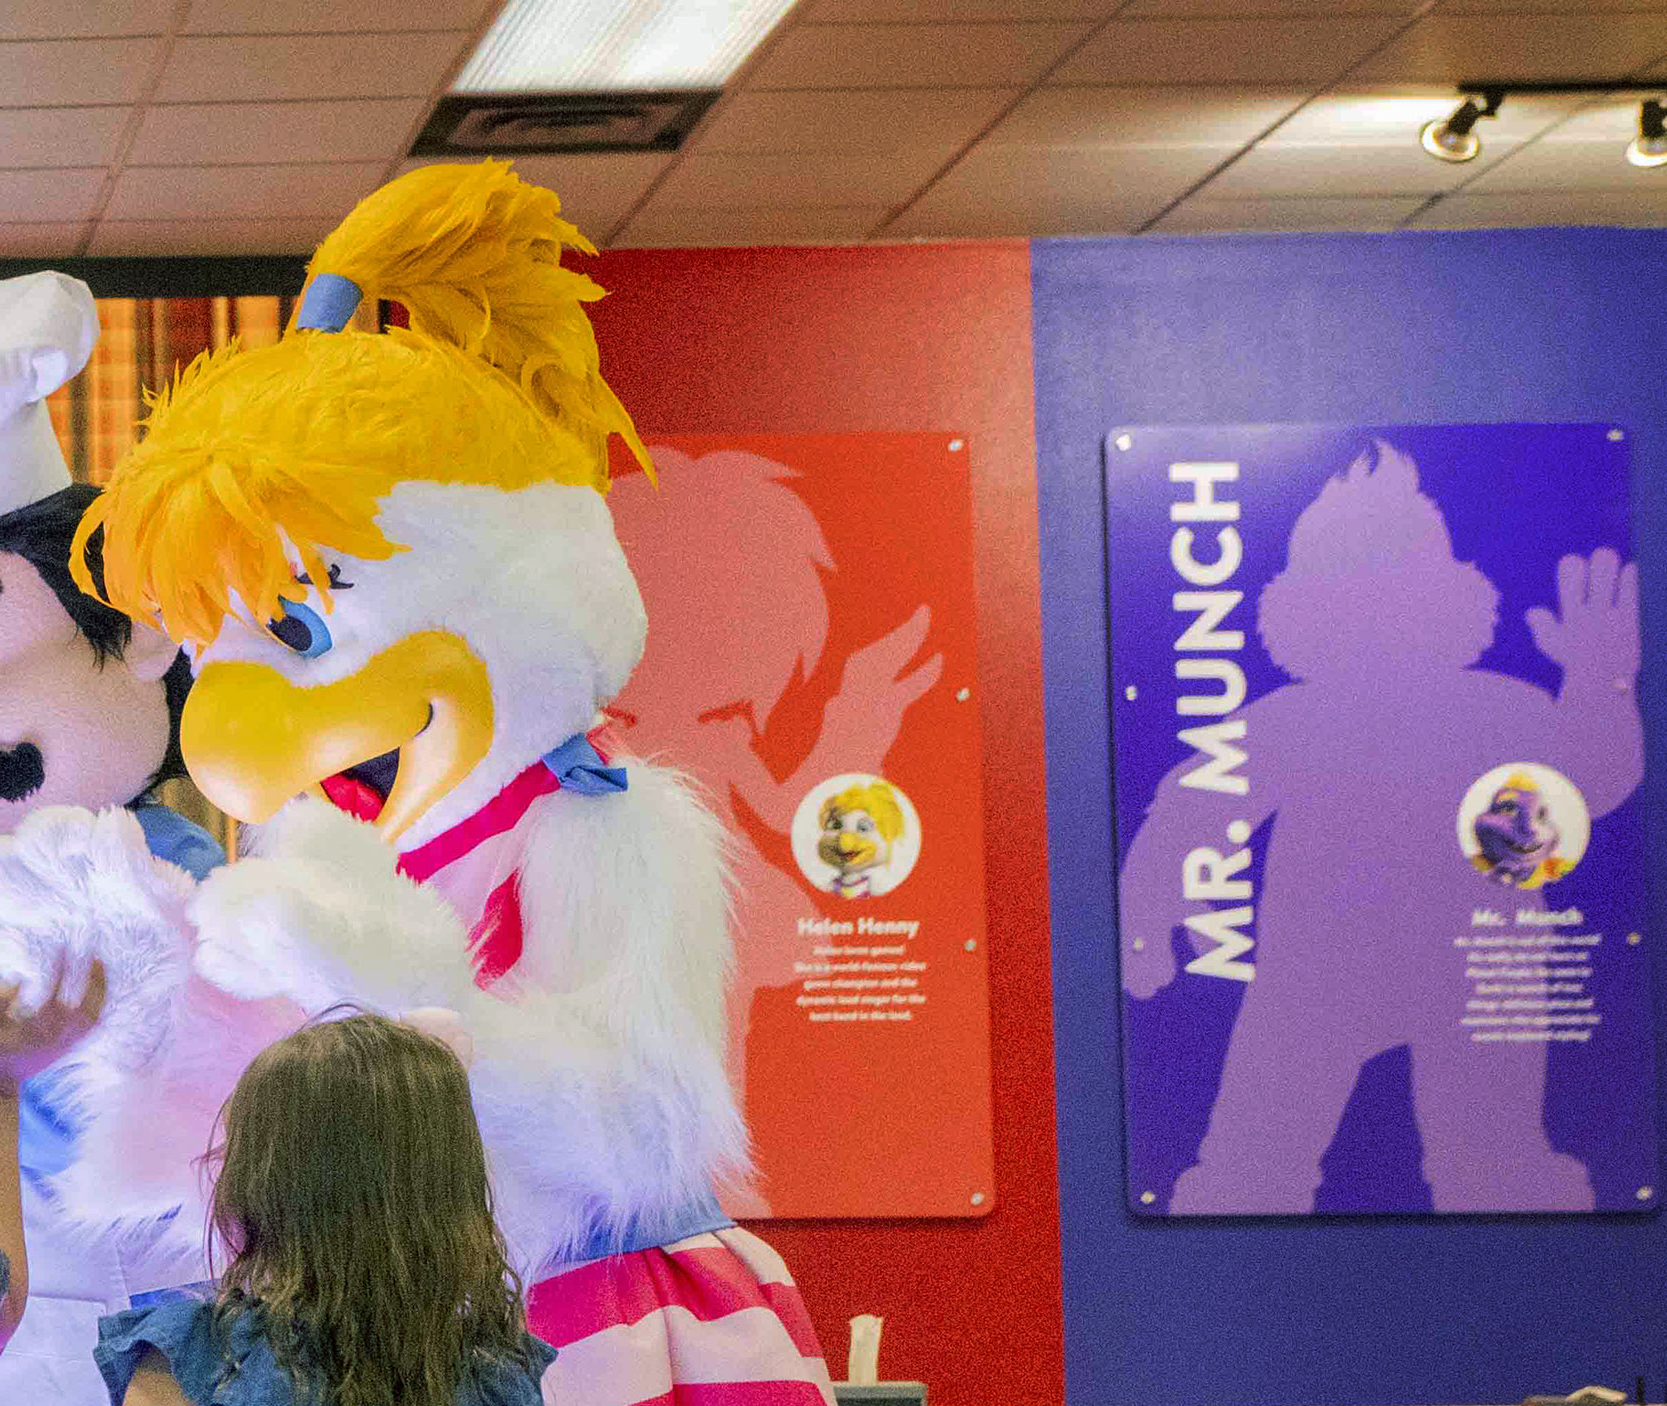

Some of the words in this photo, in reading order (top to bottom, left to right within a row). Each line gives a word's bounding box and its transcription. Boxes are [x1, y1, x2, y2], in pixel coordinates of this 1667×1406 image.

[1168, 461, 1251, 795] MUNCH
[797, 917, 853, 936] Helen
[1181, 818, 1256, 983] MR.
